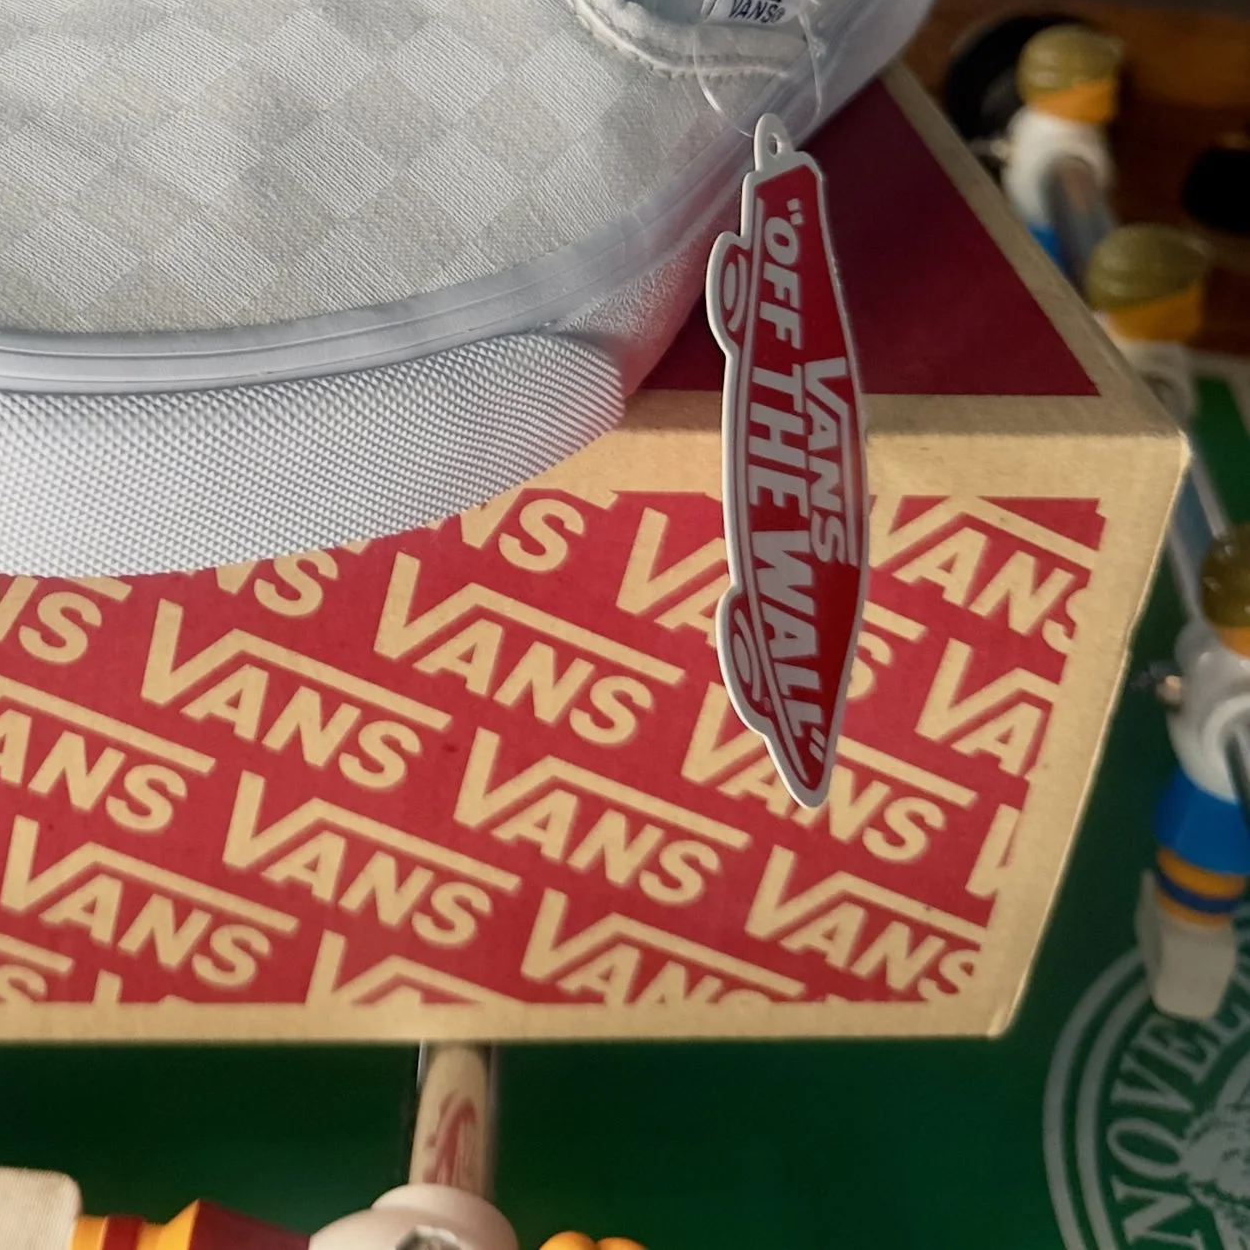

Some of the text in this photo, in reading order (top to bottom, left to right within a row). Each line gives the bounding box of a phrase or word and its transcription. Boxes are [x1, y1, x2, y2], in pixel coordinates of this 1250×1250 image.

[749, 363, 810, 518] THE
[803, 356, 859, 568] VANS
[140, 597, 453, 789] VANS
[372, 550, 686, 747] VANS
[914, 637, 1059, 778] VA
[0, 814, 300, 988] VANS
[221, 769, 522, 947] VANS
[453, 726, 752, 906] VANS
[520, 887, 805, 1004] VAN
[744, 844, 986, 1003] VANS
